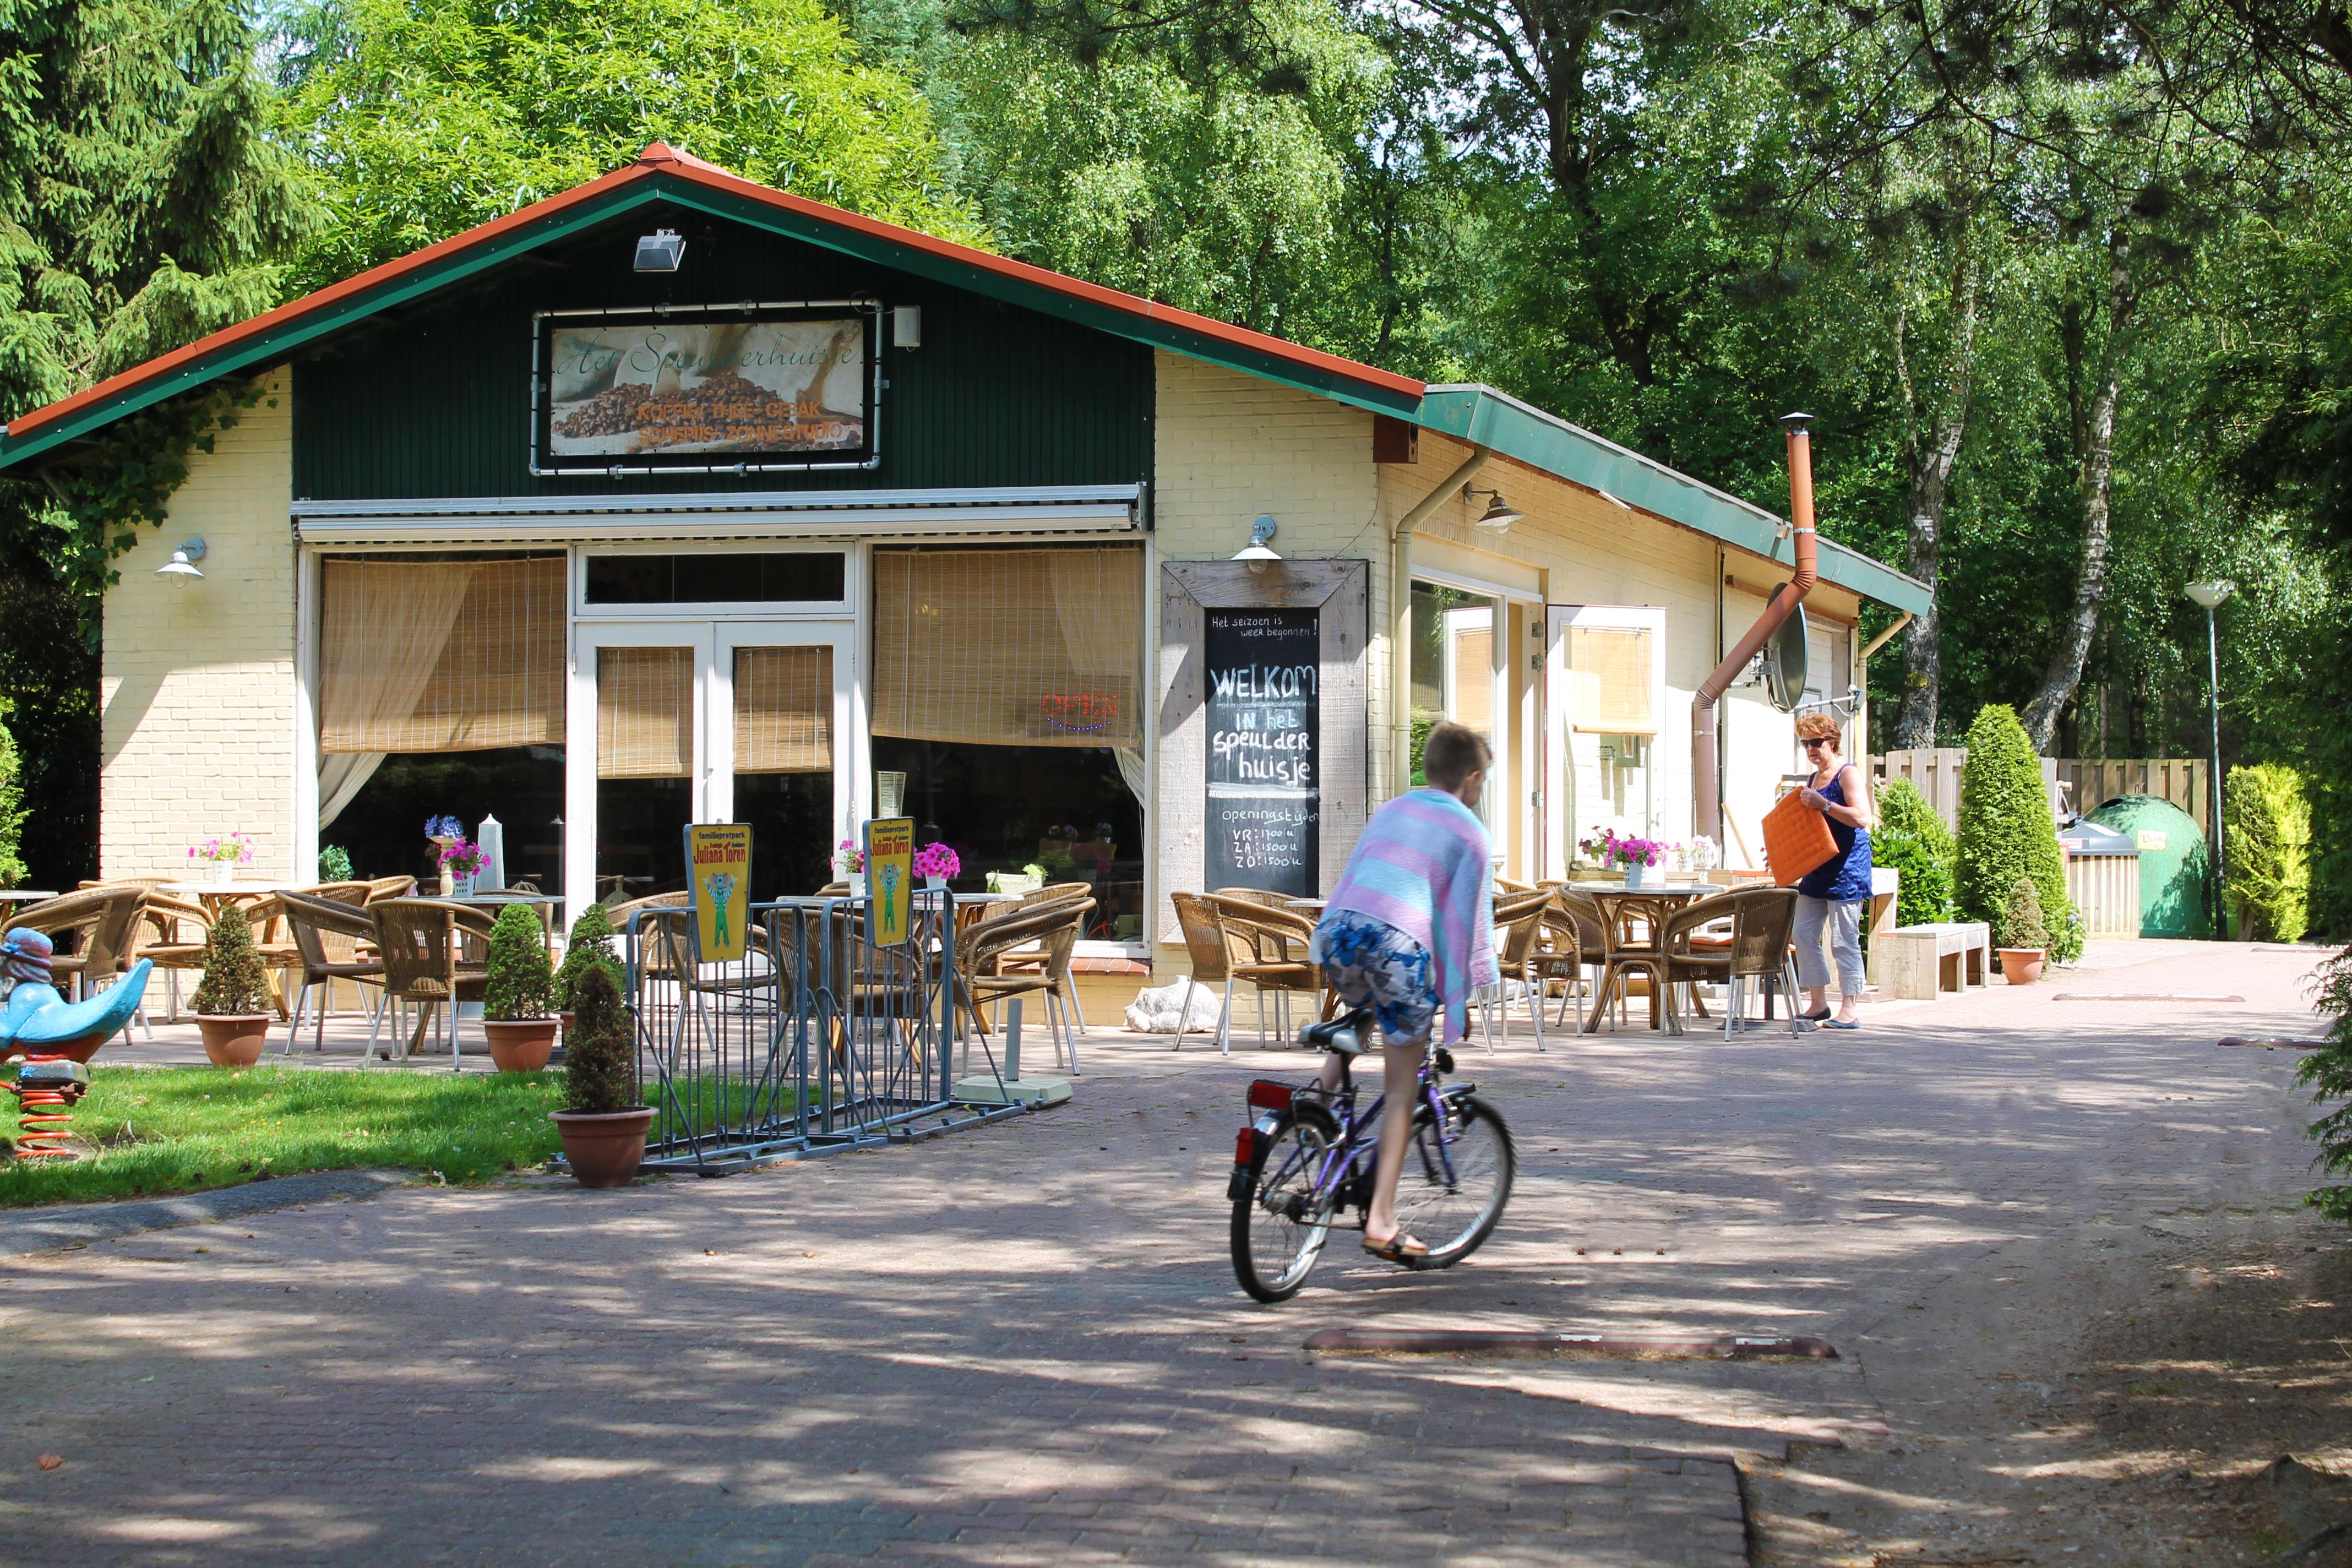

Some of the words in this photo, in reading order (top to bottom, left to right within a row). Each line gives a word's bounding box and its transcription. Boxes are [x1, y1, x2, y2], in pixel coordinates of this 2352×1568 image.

[557, 334, 617, 374] Het
[766, 400, 822, 417] GEBAK
[726, 421, 843, 441] ZONNESTUDIO
[1212, 616, 1229, 628] Het
[1232, 615, 1270, 627] seizoen
[1274, 614, 1282, 625] is
[1210, 662, 1317, 699] WELKOM
[1236, 711, 1256, 731] IN
[1267, 709, 1298, 729] het
[1239, 752, 1311, 787] huisje
[699, 831, 745, 840] familiepretpark
[870, 838, 892, 857] Juliana
[892, 835, 909, 854] Toren
[694, 843, 723, 864] Juliana
[723, 841, 745, 863] Toren
